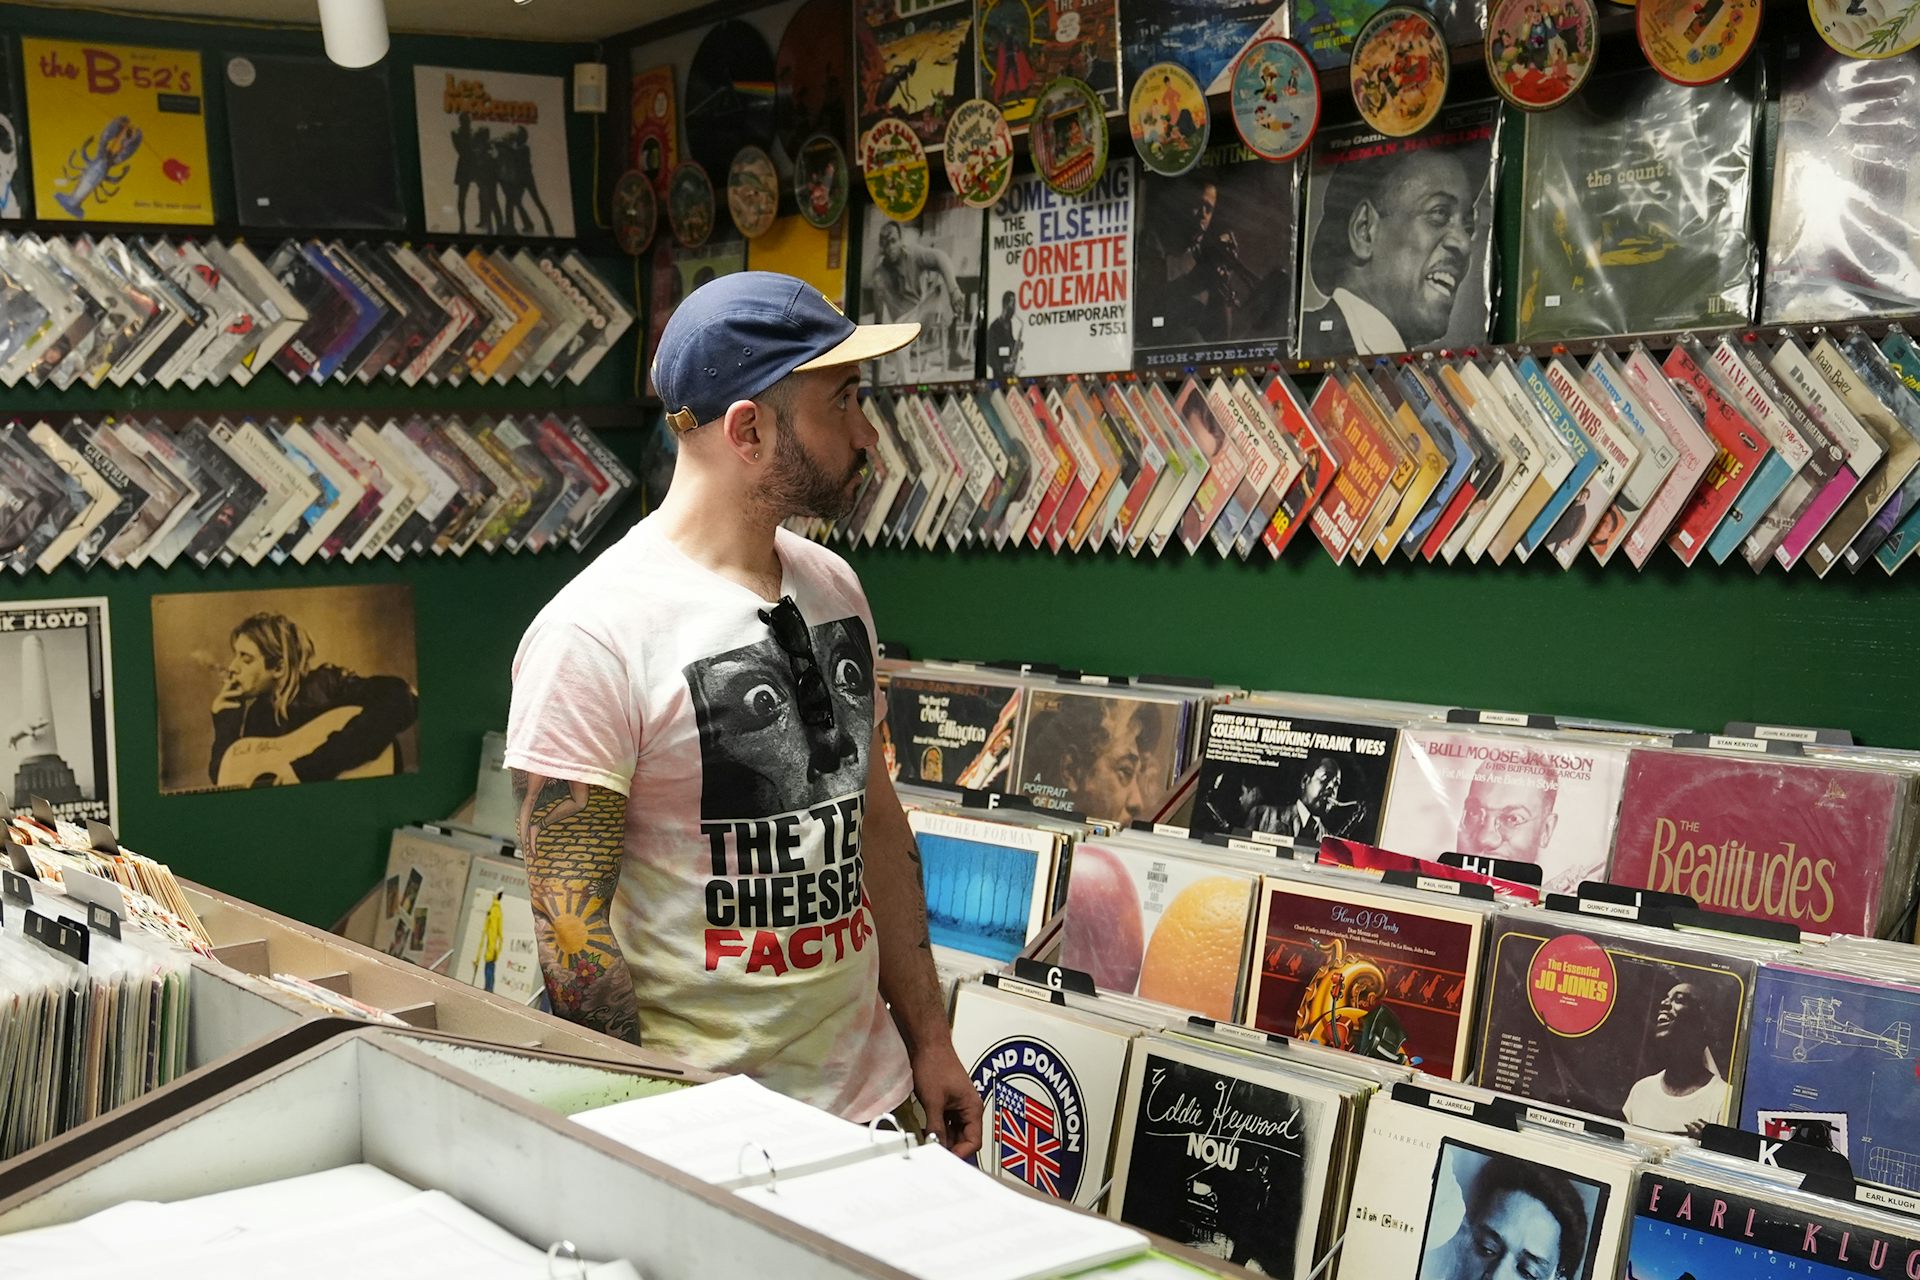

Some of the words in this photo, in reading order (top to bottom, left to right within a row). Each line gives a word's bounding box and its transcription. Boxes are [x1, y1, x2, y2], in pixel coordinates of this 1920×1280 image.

[40, 51, 79, 80] the
[83, 48, 191, 94] B-52's
[1587, 171, 1612, 188] the
[1617, 161, 1673, 182] count!
[1002, 216, 1025, 232] THE
[994, 232, 1033, 250] MUSIC
[1006, 251, 1022, 265] OF
[1023, 235, 1127, 278] ORNETTE
[1019, 269, 1127, 311] COLEMAN
[1028, 304, 1127, 326] CONTEMPORARY
[1146, 347, 1278, 365] HIGH-FIDELITY
[1816, 351, 1835, 377] Joan
[1715, 347, 1748, 396] DUANE
[1745, 385, 1774, 421] EDDY
[1550, 367, 1576, 407] GARY
[1574, 394, 1602, 438] LEWIS
[1592, 363, 1621, 407] Jimmy
[1622, 402, 1646, 437] Dean
[1228, 399, 1260, 447] Popeye
[1242, 393, 1266, 430] Limbo
[1267, 431, 1290, 462] Rock
[1528, 373, 1561, 422] RONNIE
[1559, 417, 1588, 458] DOVE
[1348, 455, 1373, 490] with
[1366, 444, 1390, 480] love
[1332, 500, 1358, 538] Paul
[24, 611, 88, 629] FLOYD
[920, 706, 948, 724] duke
[1213, 713, 1235, 724] GIANTS
[1235, 716, 1245, 726] OF
[1246, 718, 1257, 727] THE
[1257, 718, 1278, 729] TENOR
[1278, 721, 1292, 731] SAX
[938, 719, 986, 747] ellington
[1210, 723, 1260, 742] COLEMAN
[1355, 738, 1386, 757] WESS
[1429, 741, 1462, 757] BULL
[1466, 744, 1519, 764] MOOSE
[1520, 752, 1594, 772] JACKSON
[1507, 766, 1545, 776] BUFFALO
[1023, 782, 1068, 798] PORTRAIT
[1034, 773, 1041, 782] A
[989, 793, 1000, 810] F
[1033, 796, 1048, 807] OF
[1047, 798, 1074, 813] DUKE
[925, 816, 978, 836] MITCHEL
[983, 824, 1034, 845] FORMAN
[1680, 820, 1700, 833] THE
[701, 815, 805, 876] THE
[1647, 817, 1837, 923] Beatitudes
[1331, 905, 1355, 924] Horn
[1372, 913, 1400, 934] Plenty
[1609, 907, 1630, 915] JONES
[1047, 967, 1062, 990] G
[1548, 958, 1562, 971] The
[1563, 961, 1600, 978] Essential
[1535, 971, 1557, 993] JO
[1557, 975, 1608, 1003] JONES
[1022, 1047, 1081, 1153] DOMINION
[1145, 1067, 1205, 1127] Eddie
[1210, 1079, 1304, 1147] Heywood
[1444, 1101, 1472, 1112] JARREAU
[1529, 1112, 1548, 1122] KIETH
[1548, 1116, 1576, 1129] JARRETT
[1187, 1132, 1240, 1172] NOW
[1372, 1128, 1384, 1136] AL
[1388, 1132, 1432, 1149] JARREAU
[1758, 1140, 1783, 1169] K
[1649, 1183, 1757, 1238] EARL
[1865, 1192, 1885, 1203] EARL
[1887, 1196, 1916, 1209] KLUGH
[1648, 1224, 1704, 1245] LATE
[1735, 1246, 1813, 1274] NIGHT
